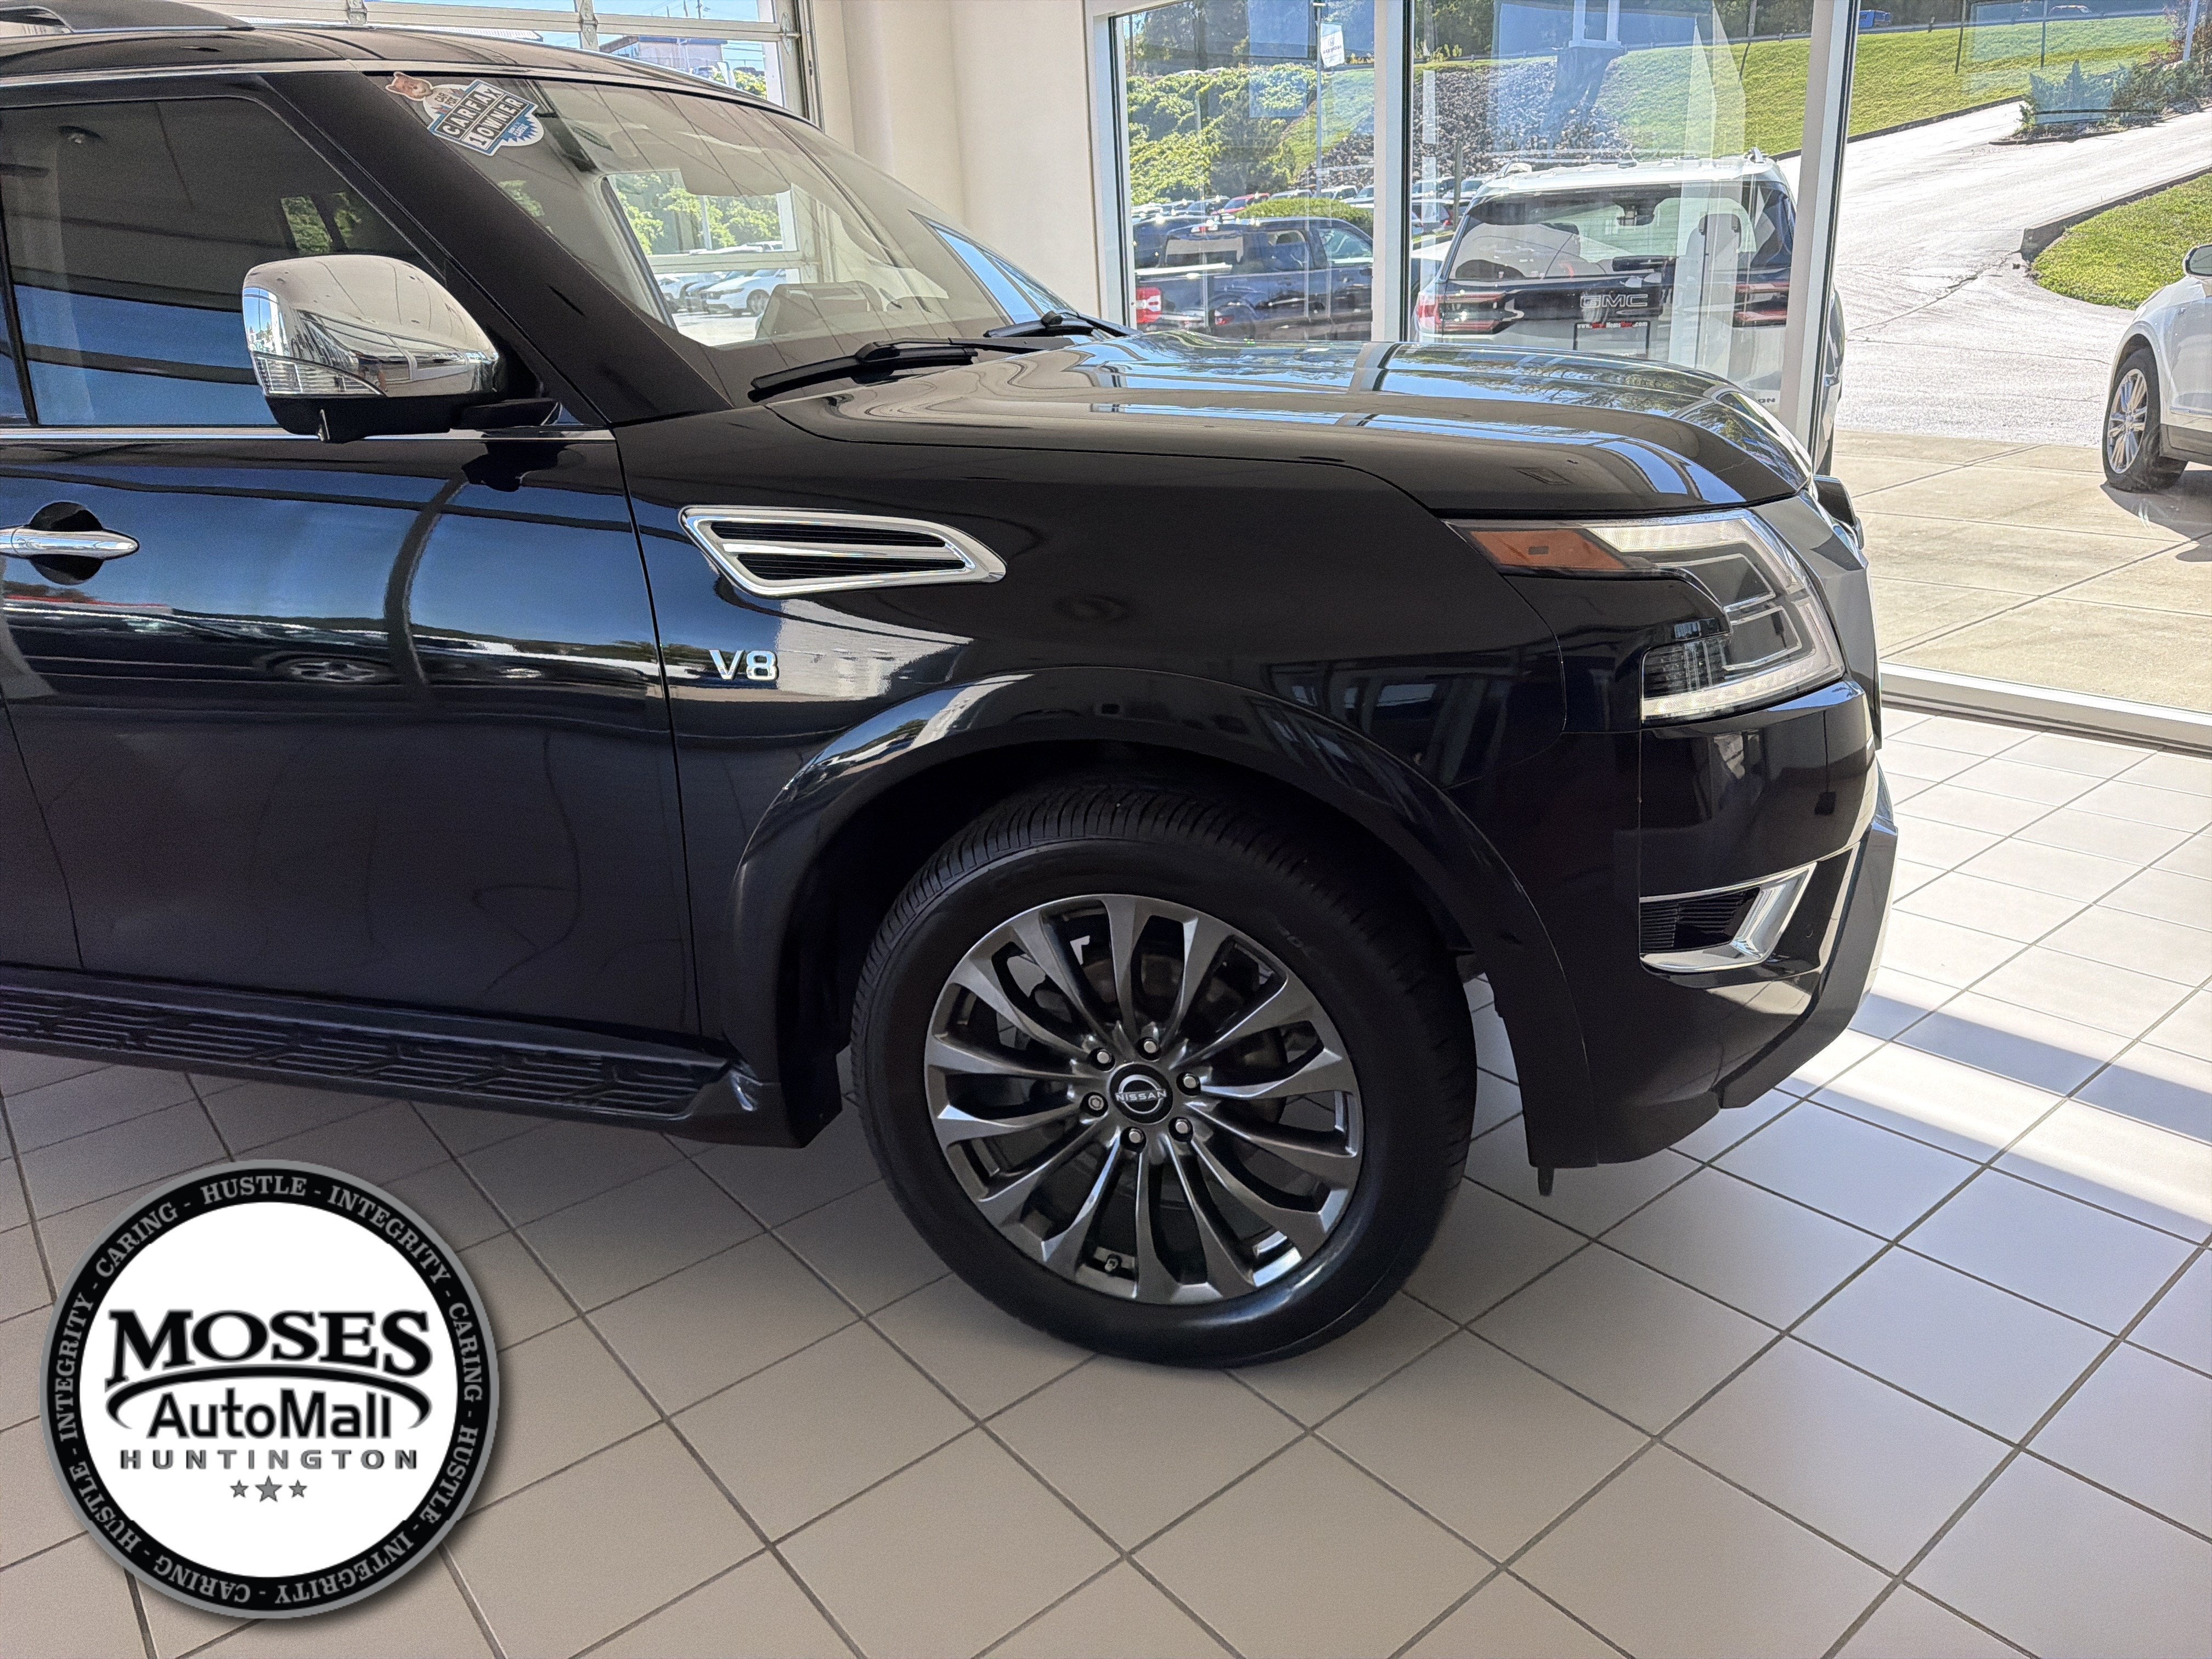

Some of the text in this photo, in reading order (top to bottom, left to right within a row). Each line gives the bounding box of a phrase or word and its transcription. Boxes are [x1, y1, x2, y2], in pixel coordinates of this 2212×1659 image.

[442, 88, 501, 136] CARFAX
[477, 97, 524, 137] OWNER
[1580, 294, 1649, 308] GMC
[709, 649, 779, 681] V8
[1115, 1090, 1166, 1102] NISSAN
